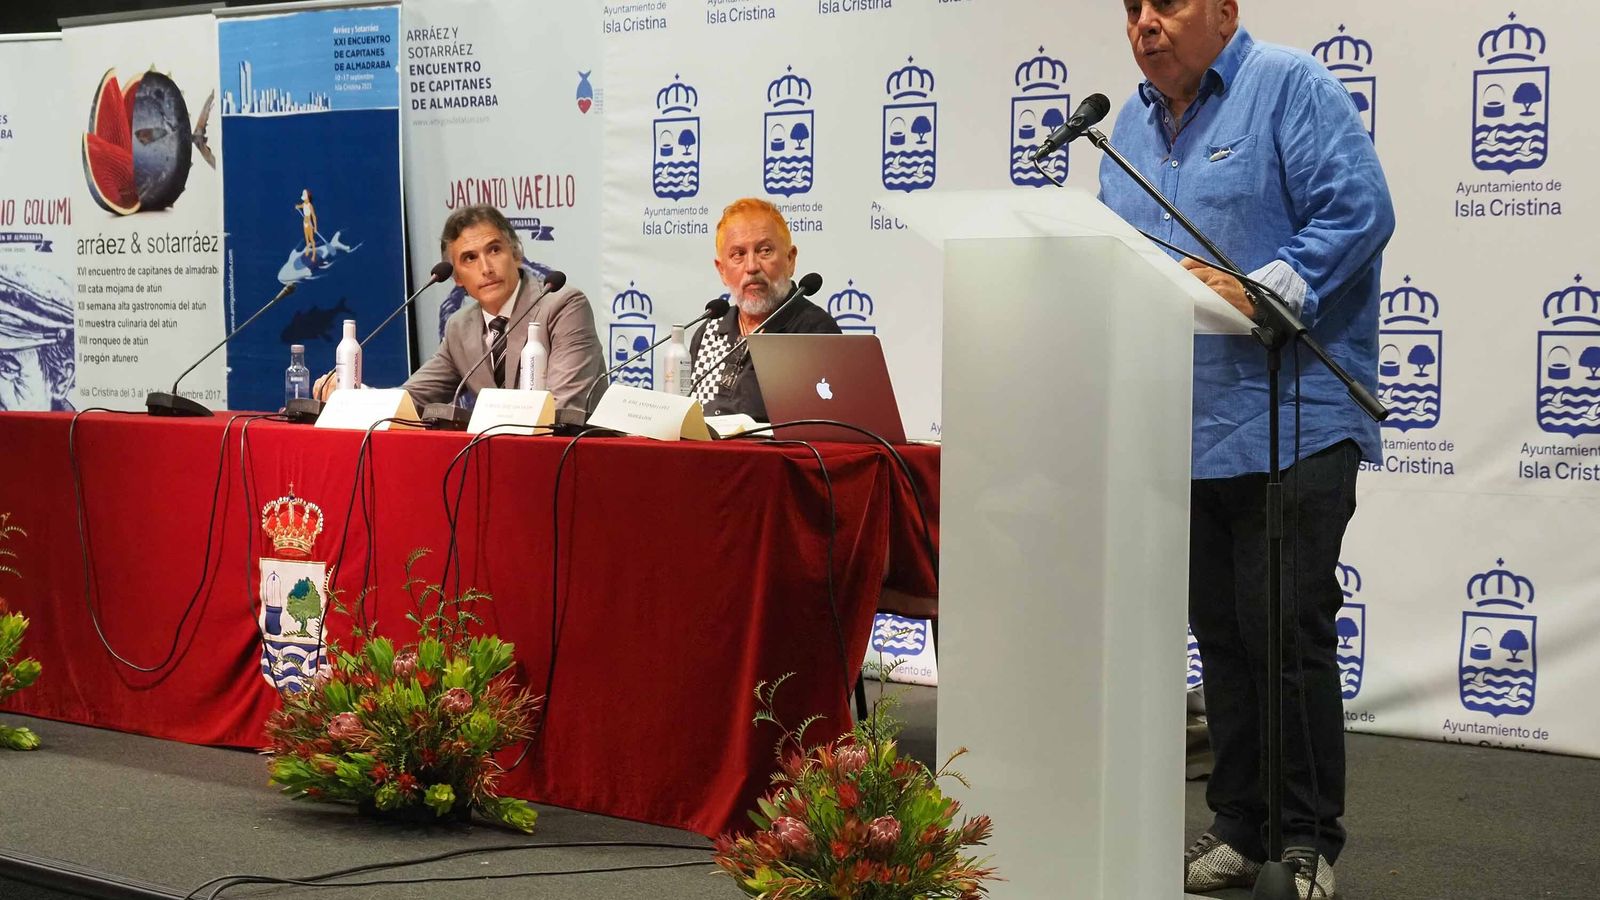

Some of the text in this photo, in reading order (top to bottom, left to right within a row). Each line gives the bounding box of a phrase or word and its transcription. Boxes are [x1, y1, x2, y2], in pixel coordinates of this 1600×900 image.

[603, 0, 667, 16] Ayuntamiento de
[707, 5, 775, 24] Isla Cristina
[818, 0, 840, 14] Isla
[603, 15, 667, 33] Isla Cristina
[333, 34, 391, 46] XXI ENCUENTRO
[407, 26, 459, 42] ARRÁEZ Y
[334, 48, 385, 59] DE CAPITANES
[408, 41, 474, 59] SOTARRÁEZ
[334, 60, 391, 71] DE ALMADRABA
[409, 60, 481, 76] ENCUENTRO
[410, 77, 492, 93] DE CAPITANES
[412, 94, 498, 110] DE ALMADRABA
[445, 174, 575, 211] JACINTO VAELLO
[1456, 179, 1562, 197] Ayuntamiento de
[644, 205, 709, 219] Ayuntamiento de
[811, 202, 823, 212] de
[1455, 198, 1562, 217] Isla Cristina
[642, 220, 708, 235] Isla Cristina
[871, 215, 892, 230] Isla
[77, 230, 219, 255] arráez & sotarráez
[77, 267, 87, 276] XVI
[87, 267, 126, 276] encuentro
[127, 266, 136, 275] de
[137, 265, 172, 277] capitanes
[174, 265, 183, 274] de
[87, 285, 103, 293] cata
[105, 284, 134, 295] mojama
[135, 284, 145, 293] de
[146, 283, 162, 293] atún
[86, 302, 116, 311] semana
[117, 301, 130, 310] alta
[131, 301, 176, 313] gastronomía
[178, 301, 190, 310] del
[191, 300, 207, 310] atún
[85, 319, 116, 328] muestra
[117, 318, 147, 328] culinaria
[149, 318, 160, 328] del
[161, 318, 178, 328] atún
[89, 337, 121, 347] ronqueo
[122, 336, 131, 345] de
[132, 336, 149, 345] atún
[83, 353, 110, 365] pregón
[112, 353, 139, 363] atunero
[91, 387, 119, 398] Cristina
[120, 387, 130, 397] del
[131, 388, 136, 397] 3
[137, 388, 144, 398] al
[205, 389, 221, 400] 2017
[1439, 440, 1455, 452] de
[1386, 455, 1455, 475] Cristina
[1519, 461, 1551, 479] Isla
[1361, 710, 1376, 723] de
[1443, 719, 1549, 741] Ayuntamiento de
